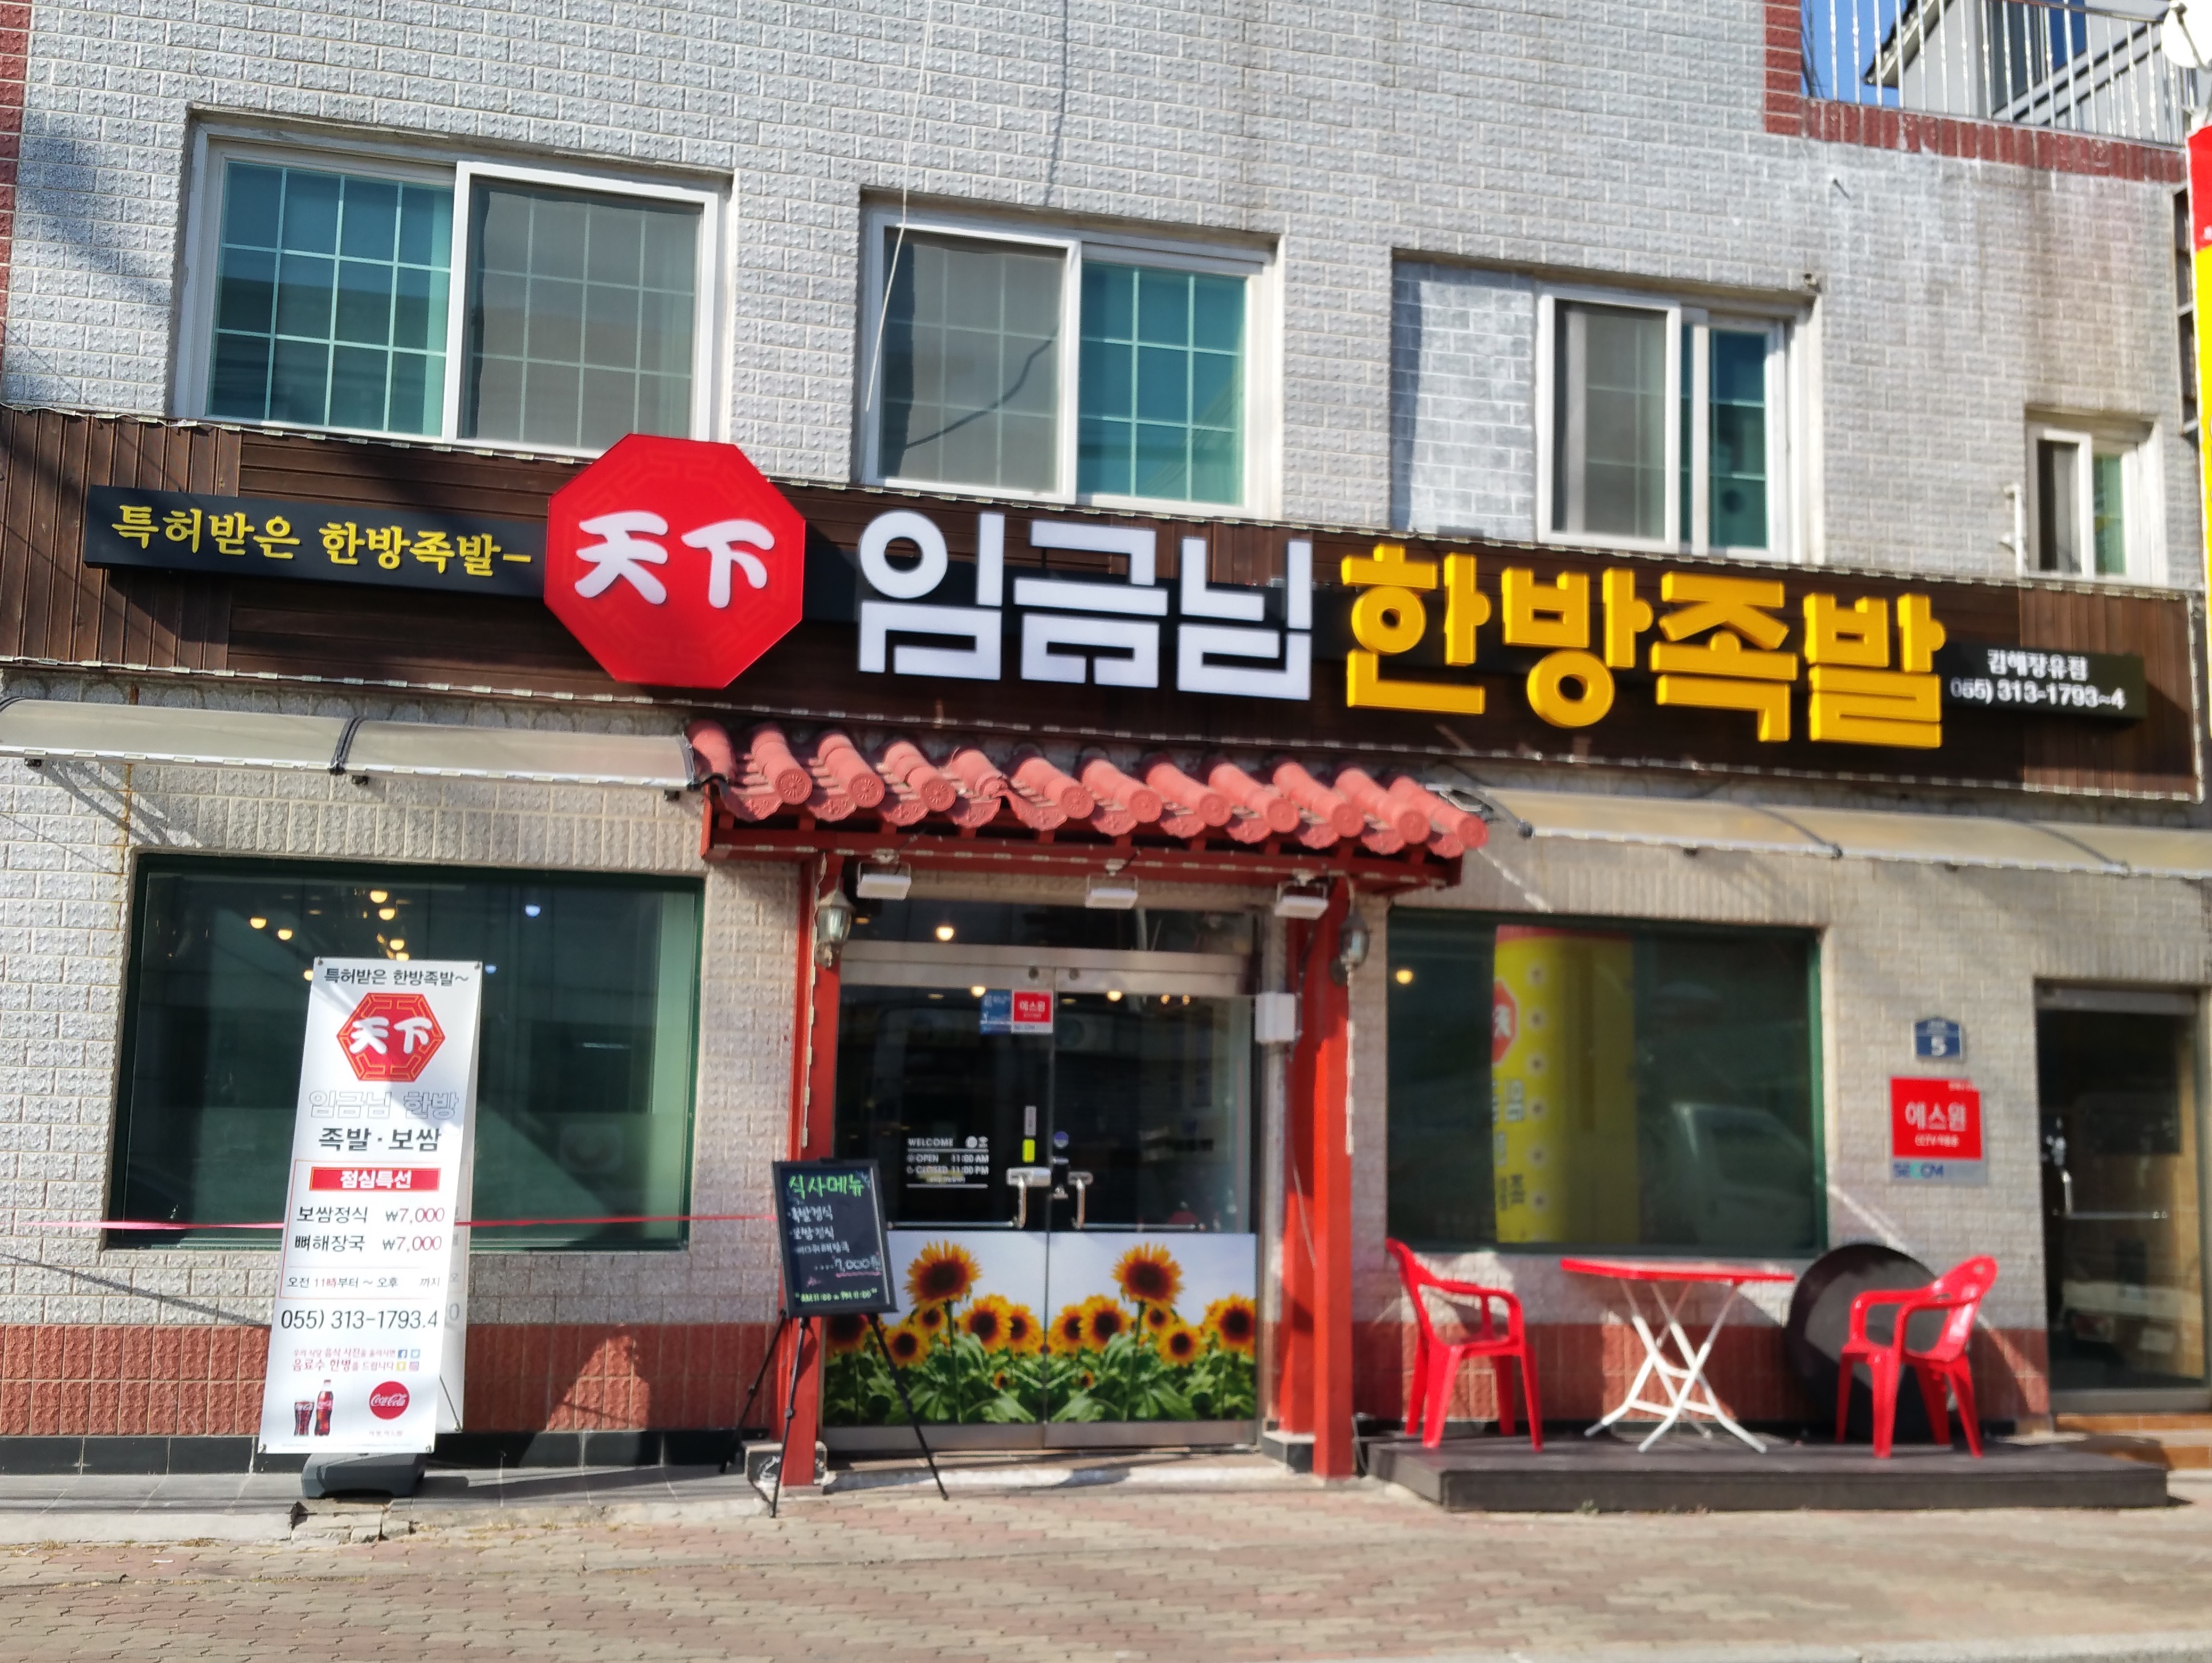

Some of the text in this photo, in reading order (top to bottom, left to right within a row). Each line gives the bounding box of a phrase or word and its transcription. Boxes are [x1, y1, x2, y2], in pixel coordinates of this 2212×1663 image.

[112, 504, 300, 559] 특허받은
[575, 510, 775, 608] 天下
[858, 509, 1945, 748] 임금님 한방족발
[324, 968, 386, 985] 특허받은
[349, 1016, 433, 1054] 天下
[309, 1090, 459, 1120] 임금님 한방
[1905, 1101, 1966, 1132] 에스원
[908, 1138, 954, 1147] WELCOME
[916, 1154, 939, 1163] OPEN
[975, 1154, 989, 1163] AM
[340, 1170, 412, 1189] 점심특선
[975, 1166, 989, 1175] PM
[789, 1173, 864, 1199] 식사메뉴
[296, 1206, 368, 1223] 보쌈정식
[385, 1207, 445, 1225] ₩7,000
[295, 1234, 365, 1252] 뼈해장국
[382, 1235, 442, 1253] ₩7,000
[287, 1277, 309, 1288] 오전
[377, 1277, 398, 1288] 오후
[419, 1278, 440, 1287] 까지
[281, 1310, 324, 1329] 055)
[331, 1310, 438, 1329] 313-1793.4
[293, 1359, 325, 1371] 음료수
